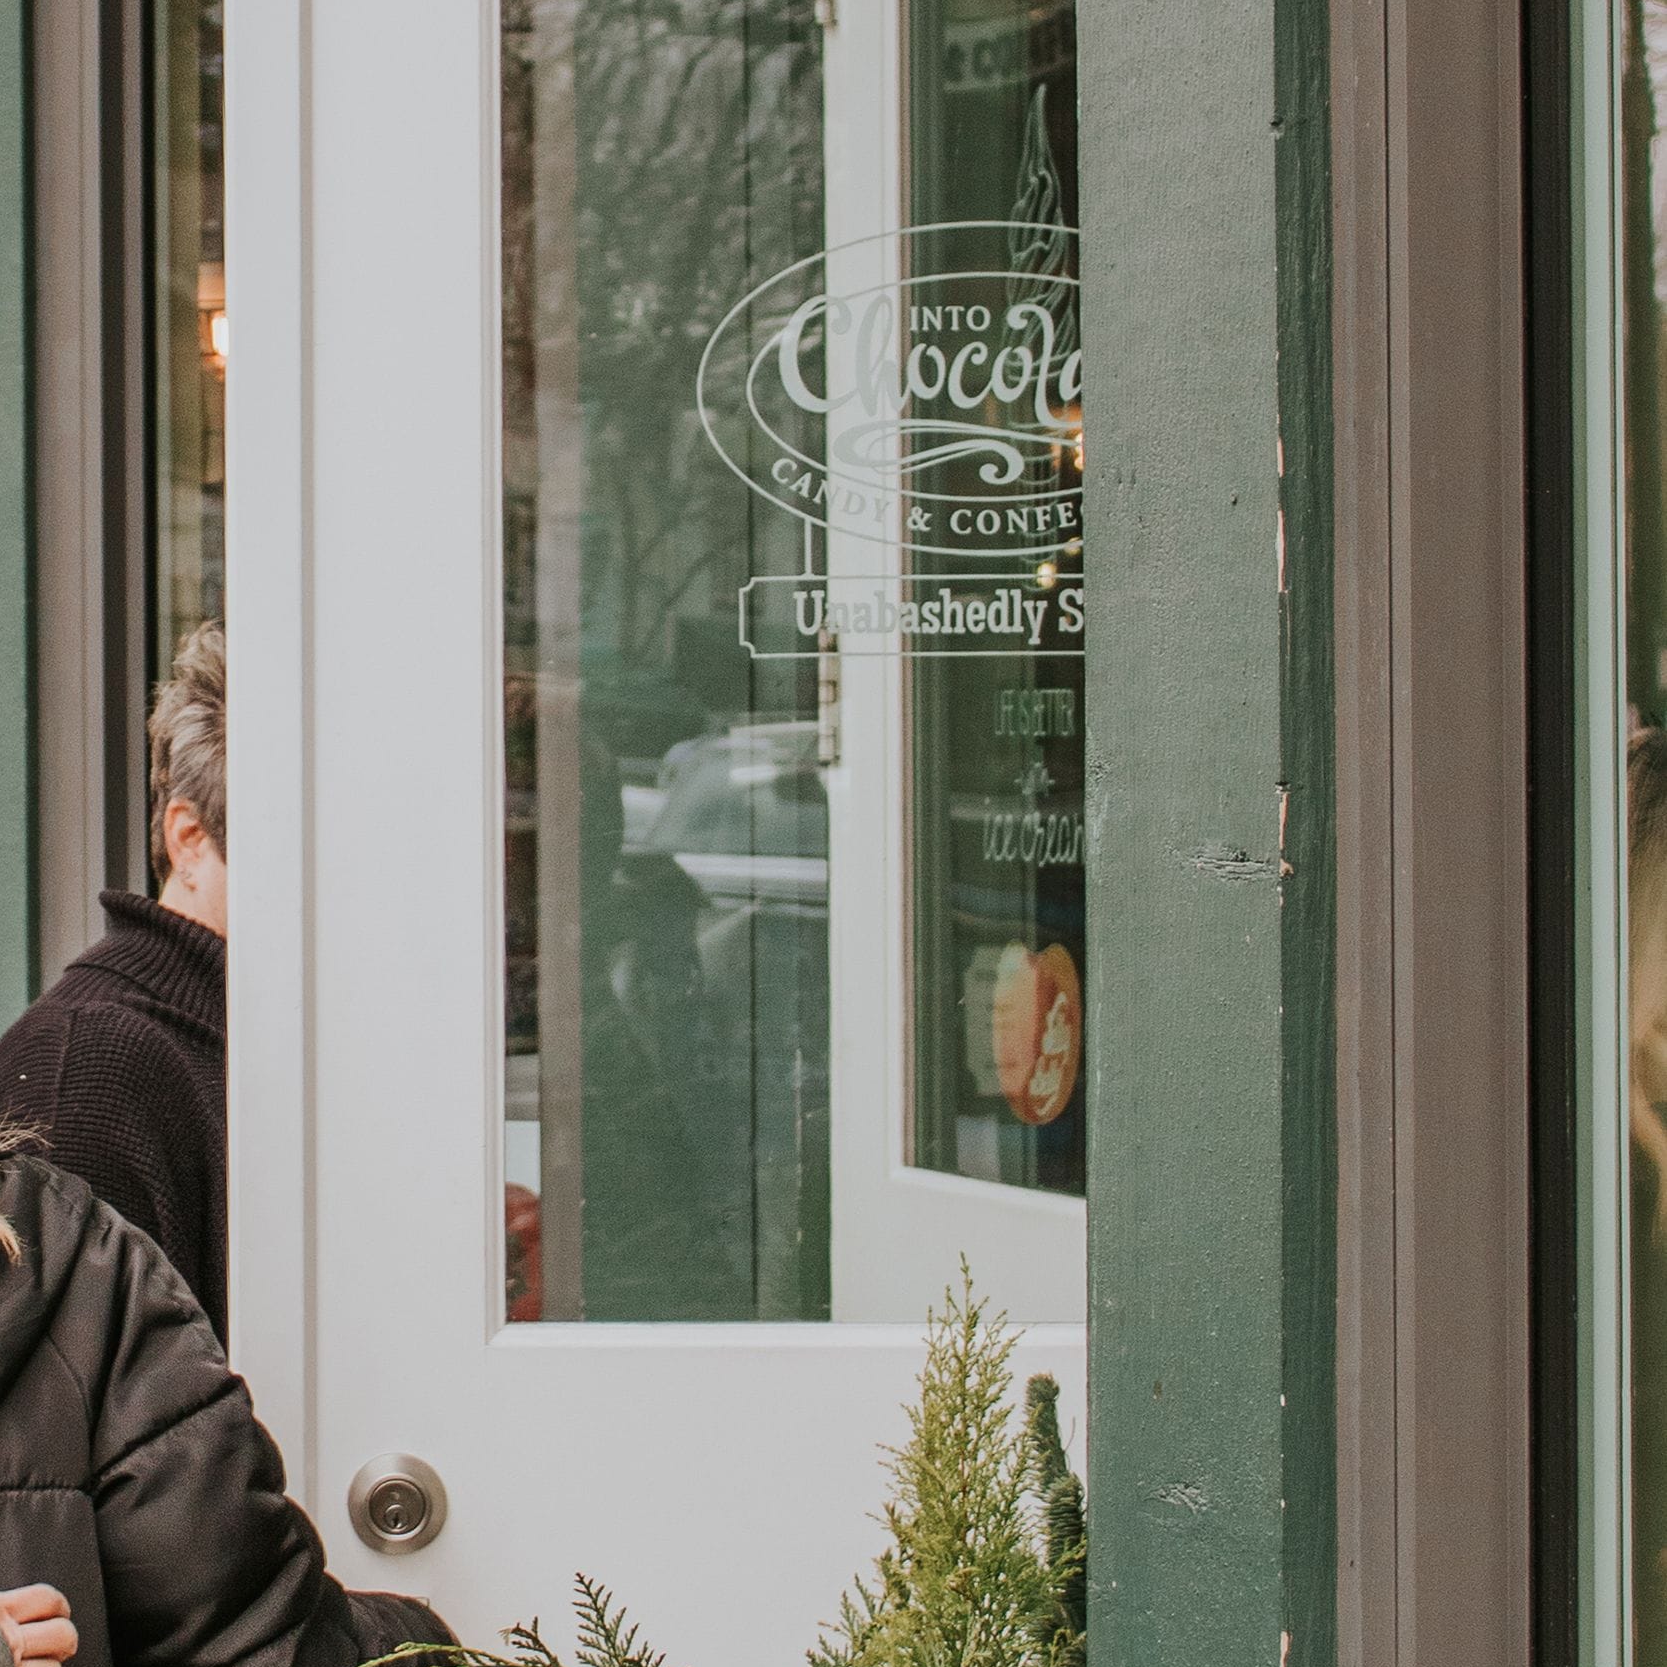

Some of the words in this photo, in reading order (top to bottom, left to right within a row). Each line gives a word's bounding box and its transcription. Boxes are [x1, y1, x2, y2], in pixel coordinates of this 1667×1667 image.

[909, 305, 991, 332] INTO
[771, 457, 890, 525] CANDY
[906, 506, 933, 533] &
[949, 501, 1083, 536] CONFE
[793, 587, 1048, 645] Unabashedly
